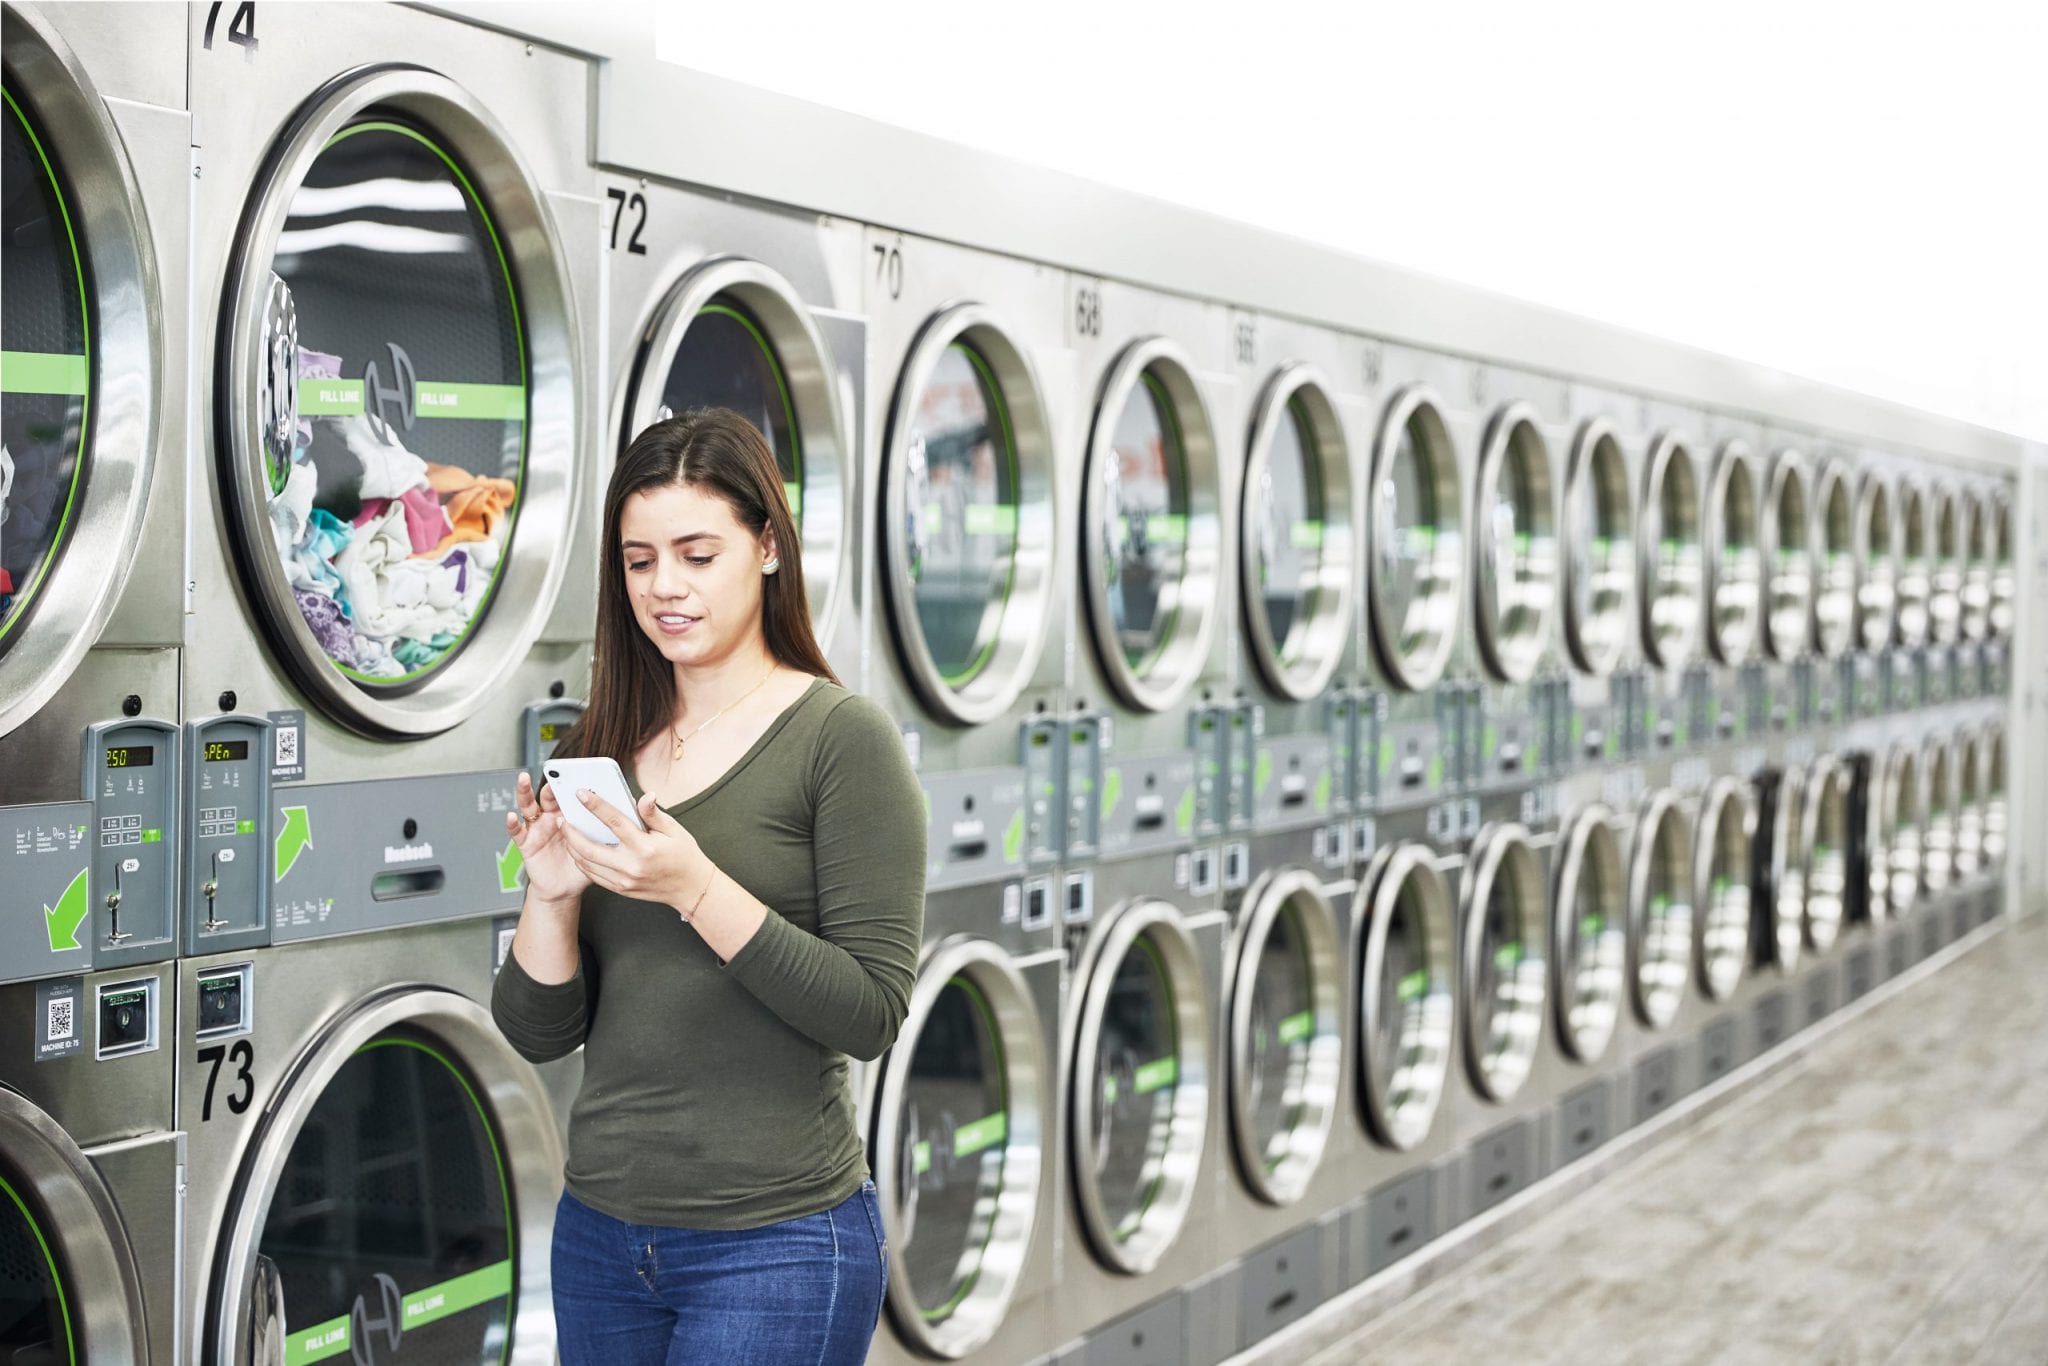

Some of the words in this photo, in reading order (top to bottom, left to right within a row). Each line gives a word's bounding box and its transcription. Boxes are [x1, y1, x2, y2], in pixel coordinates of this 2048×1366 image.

[607, 186, 647, 256] 72
[873, 245, 903, 301] 70
[320, 390, 338, 403] FILL
[340, 390, 360, 403] LINE
[420, 392, 438, 405] FILL
[439, 393, 458, 406] LINE
[41, 1041, 65, 1053] MACHINE
[197, 1039, 255, 1122] 73
[407, 1302, 425, 1317] FILL
[425, 1293, 444, 1310] LINE
[305, 1337, 324, 1352] FILL
[325, 1327, 345, 1345] LINE
